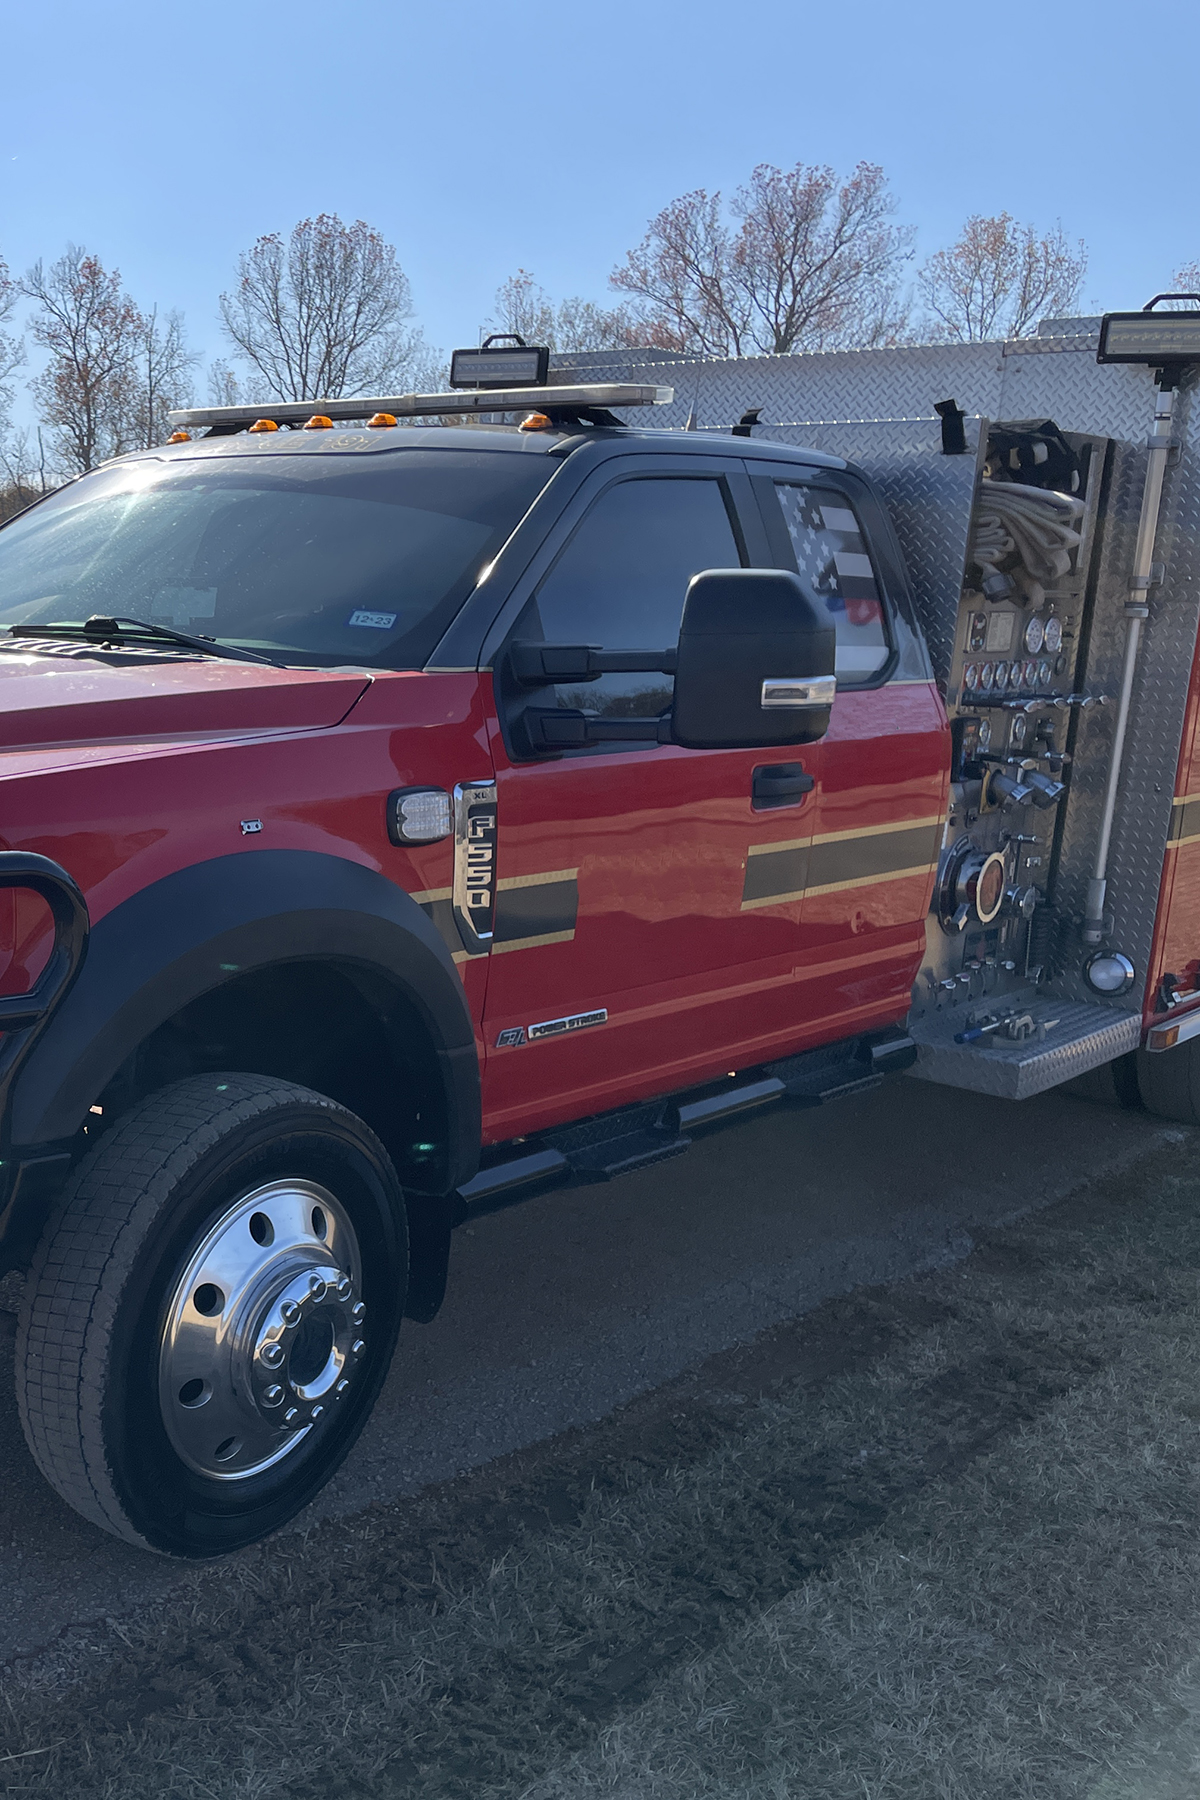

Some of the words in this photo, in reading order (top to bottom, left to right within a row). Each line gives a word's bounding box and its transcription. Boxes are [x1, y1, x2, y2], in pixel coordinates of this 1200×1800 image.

[473, 792, 487, 800] XL
[532, 1021, 567, 1037] POWER
[568, 1011, 606, 1028] STROKE
